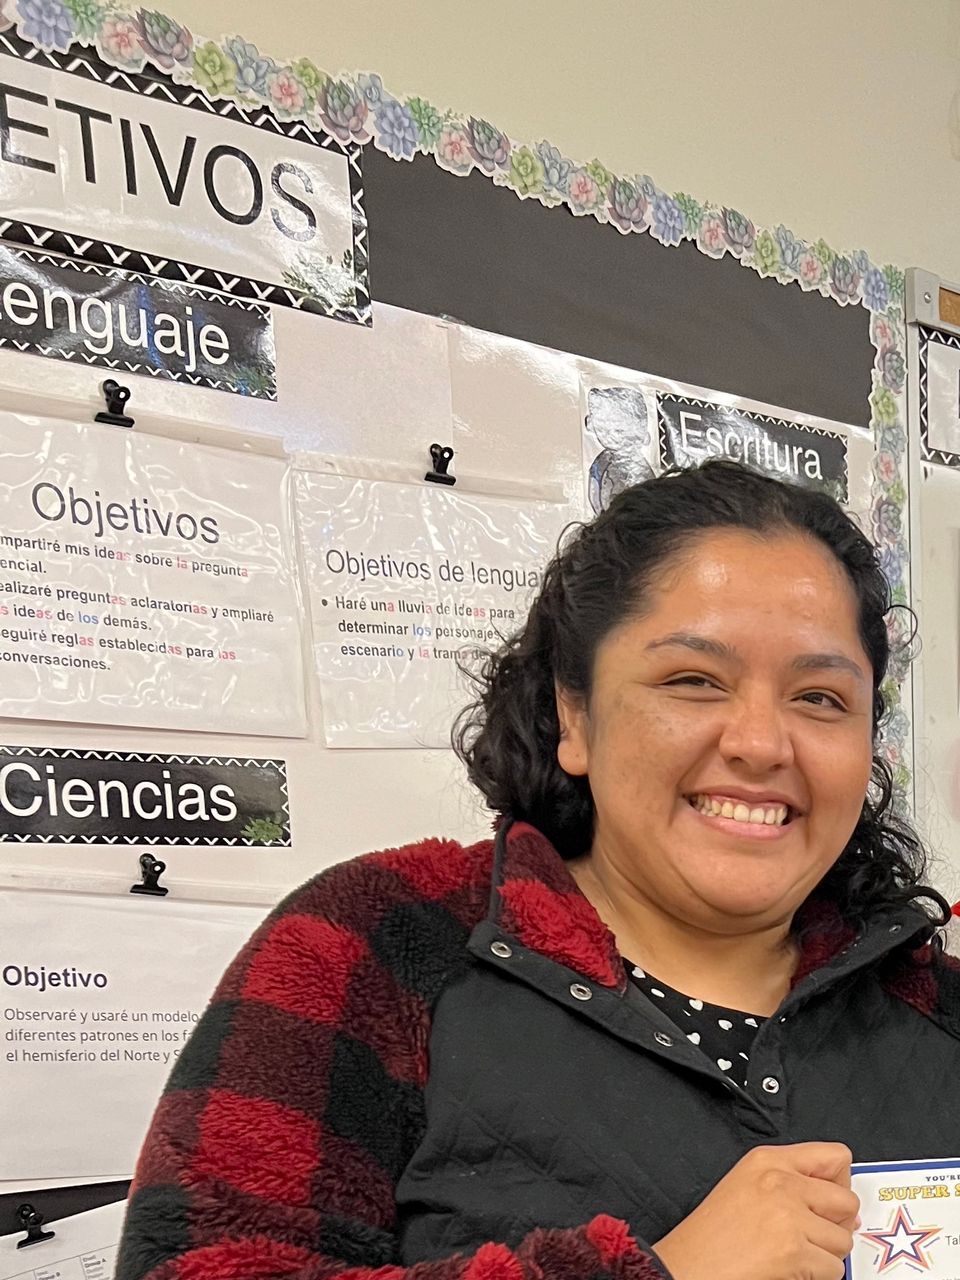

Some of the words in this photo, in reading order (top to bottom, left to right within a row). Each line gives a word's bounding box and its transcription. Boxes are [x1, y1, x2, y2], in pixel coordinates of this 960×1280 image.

[0, 281, 231, 372] enguaje
[679, 411, 823, 480] Escritura
[32, 483, 220, 543] Objetivos
[65, 543, 90, 556] mis
[95, 545, 131, 560] ideas
[135, 552, 173, 567] sobre
[177, 557, 188, 569] la
[192, 561, 248, 577] pregunta
[326, 549, 431, 581] Objetivos
[439, 559, 464, 582] de
[471, 561, 543, 592] lengua
[13, 604, 52, 620] ideas
[57, 610, 74, 622] de
[79, 611, 99, 625] los
[103, 615, 152, 630] demás.
[57, 588, 127, 606] preguntas
[130, 597, 208, 615] aclaratorias
[211, 607, 218, 618] y
[222, 608, 274, 622] ampliaré
[335, 596, 367, 611] Haré
[371, 601, 394, 612] una
[398, 600, 432, 614] lluvia
[436, 603, 450, 615] de
[454, 603, 486, 618] ideas
[489, 608, 515, 620] para
[338, 619, 408, 635] determinar
[413, 624, 431, 636] los
[52, 633, 94, 648] reglas
[99, 638, 182, 655] establecidas
[186, 647, 214, 658] para
[218, 651, 236, 660] las
[341, 645, 403, 657] escenario
[408, 648, 414, 661] y
[419, 647, 429, 659] la
[1, 762, 237, 822] Ciencias
[2, 965, 108, 992] Objetivo
[4, 1008, 77, 1021] Observaré
[80, 1011, 88, 1024] y
[92, 1010, 128, 1022] usaré
[132, 1012, 148, 1022] un
[5, 1029, 76, 1041] diferentes
[80, 1030, 139, 1044] patrones
[142, 1032, 158, 1041] en
[161, 1030, 179, 1041] los
[6, 1050, 18, 1061] el
[22, 1049, 96, 1062] hemisferio
[100, 1050, 120, 1061] del
[124, 1050, 160, 1061] Norte
[163, 1052, 170, 1064] y
[878, 1184, 950, 1201] SUPER
